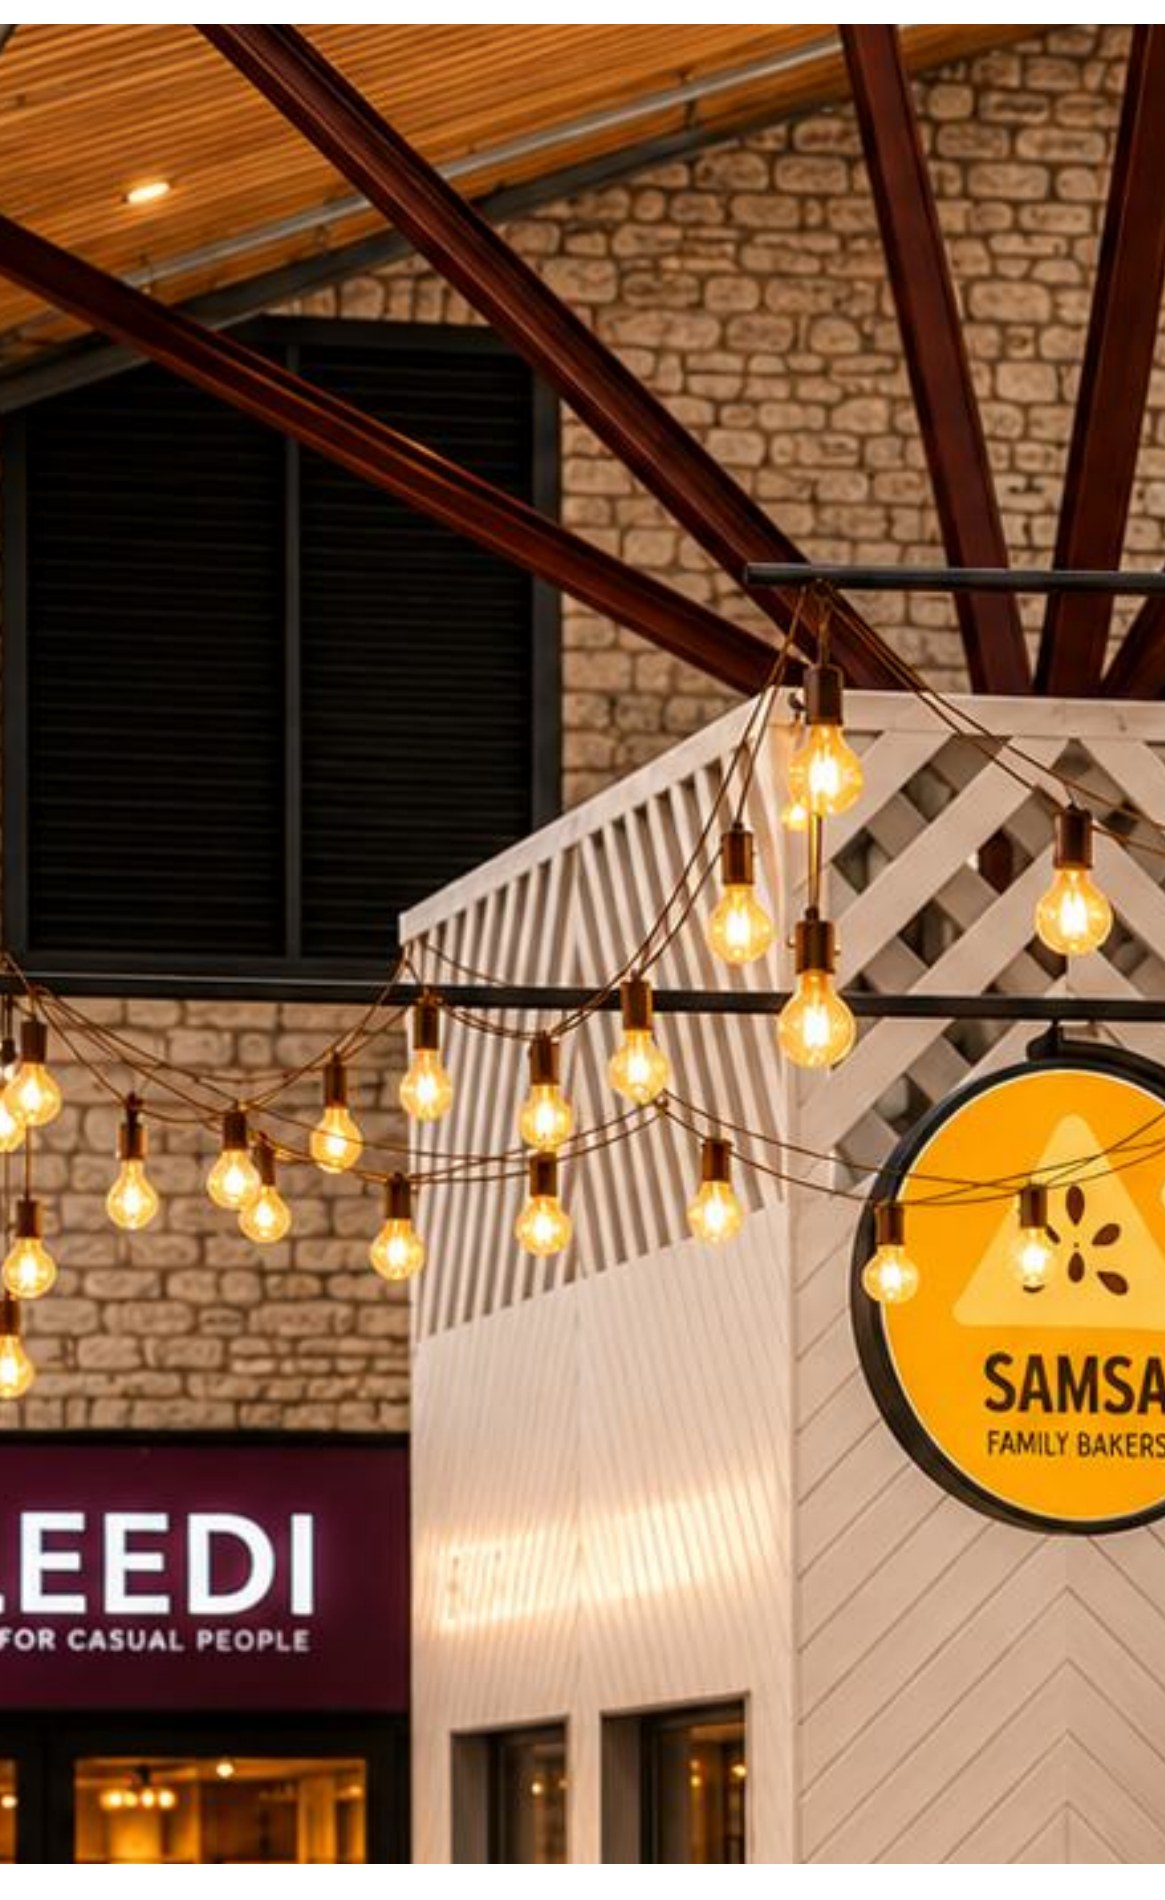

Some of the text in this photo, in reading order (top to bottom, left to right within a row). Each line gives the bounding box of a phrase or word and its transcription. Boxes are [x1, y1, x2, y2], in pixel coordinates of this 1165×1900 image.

[988, 1430, 1069, 1456] FAMILY
[0, 1511, 314, 1615] EEDI
[0, 1628, 311, 1652] FOR CASUAL PEOPLE
